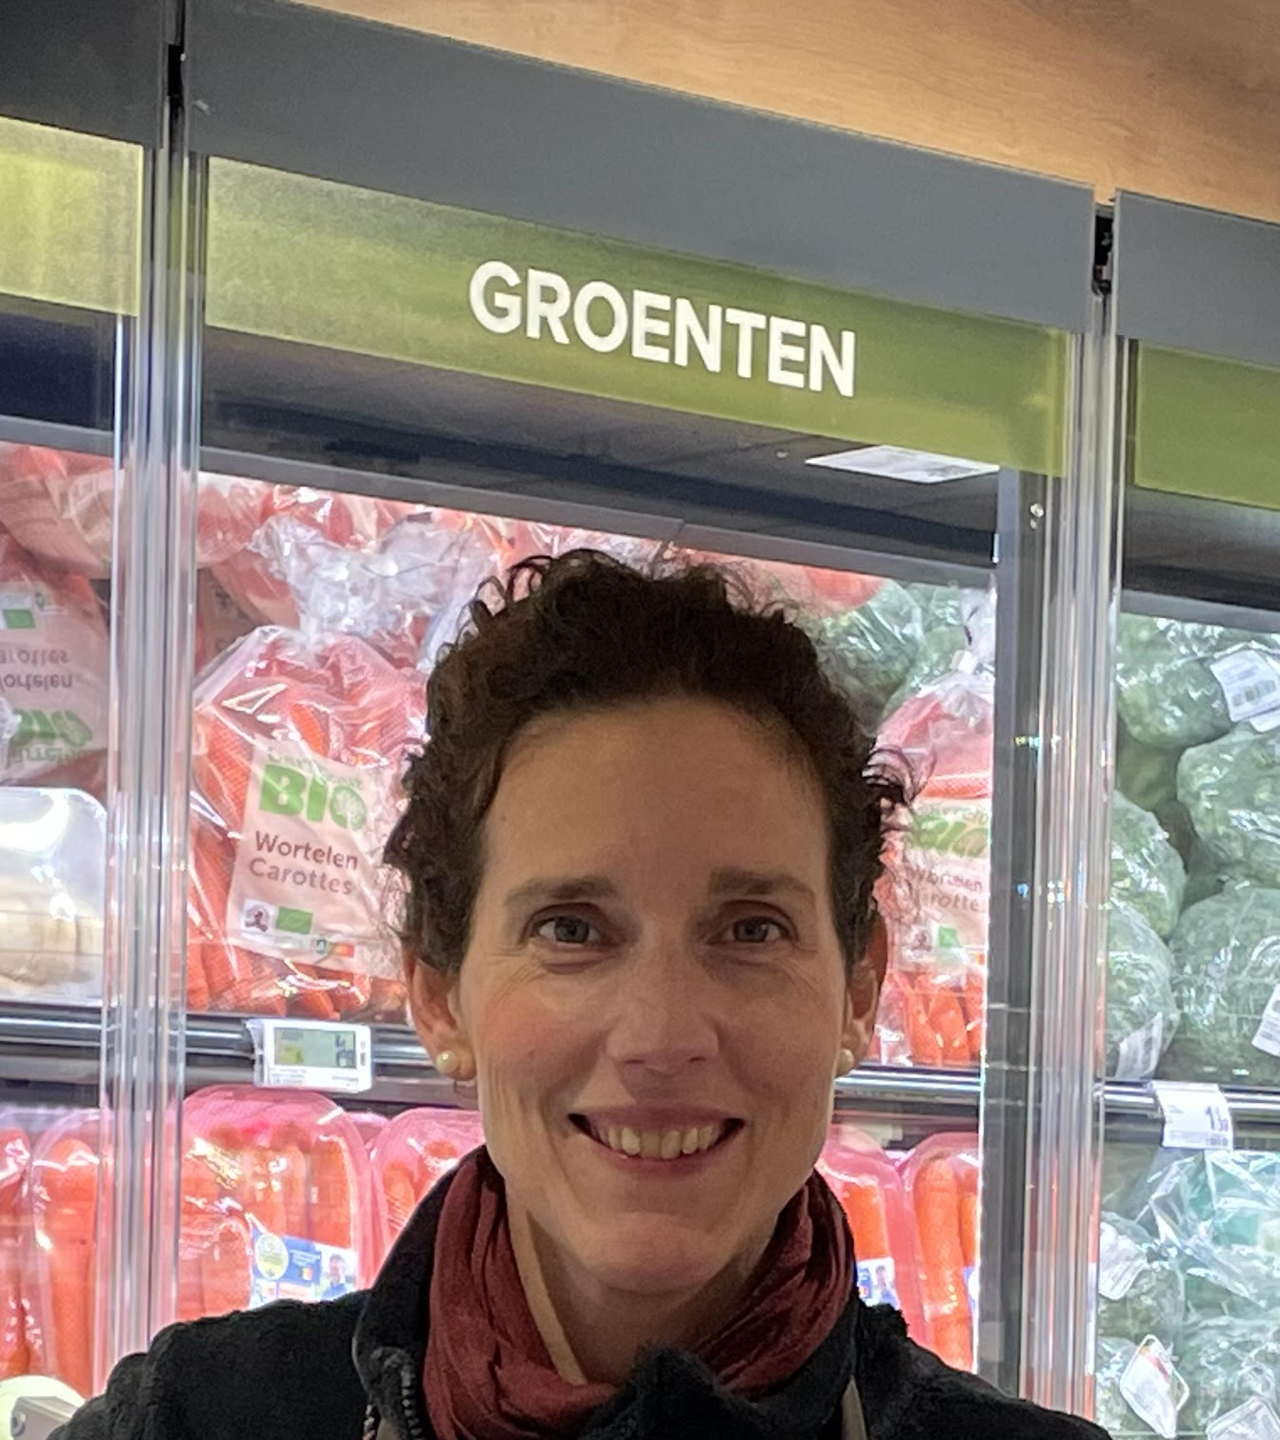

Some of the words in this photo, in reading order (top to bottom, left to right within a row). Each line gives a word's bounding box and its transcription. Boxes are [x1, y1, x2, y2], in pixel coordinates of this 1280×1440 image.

[468, 260, 857, 398] GROENTEN
[260, 764, 367, 832] BIO
[249, 857, 354, 897] Carottes
[253, 830, 359, 872] Wortelen
